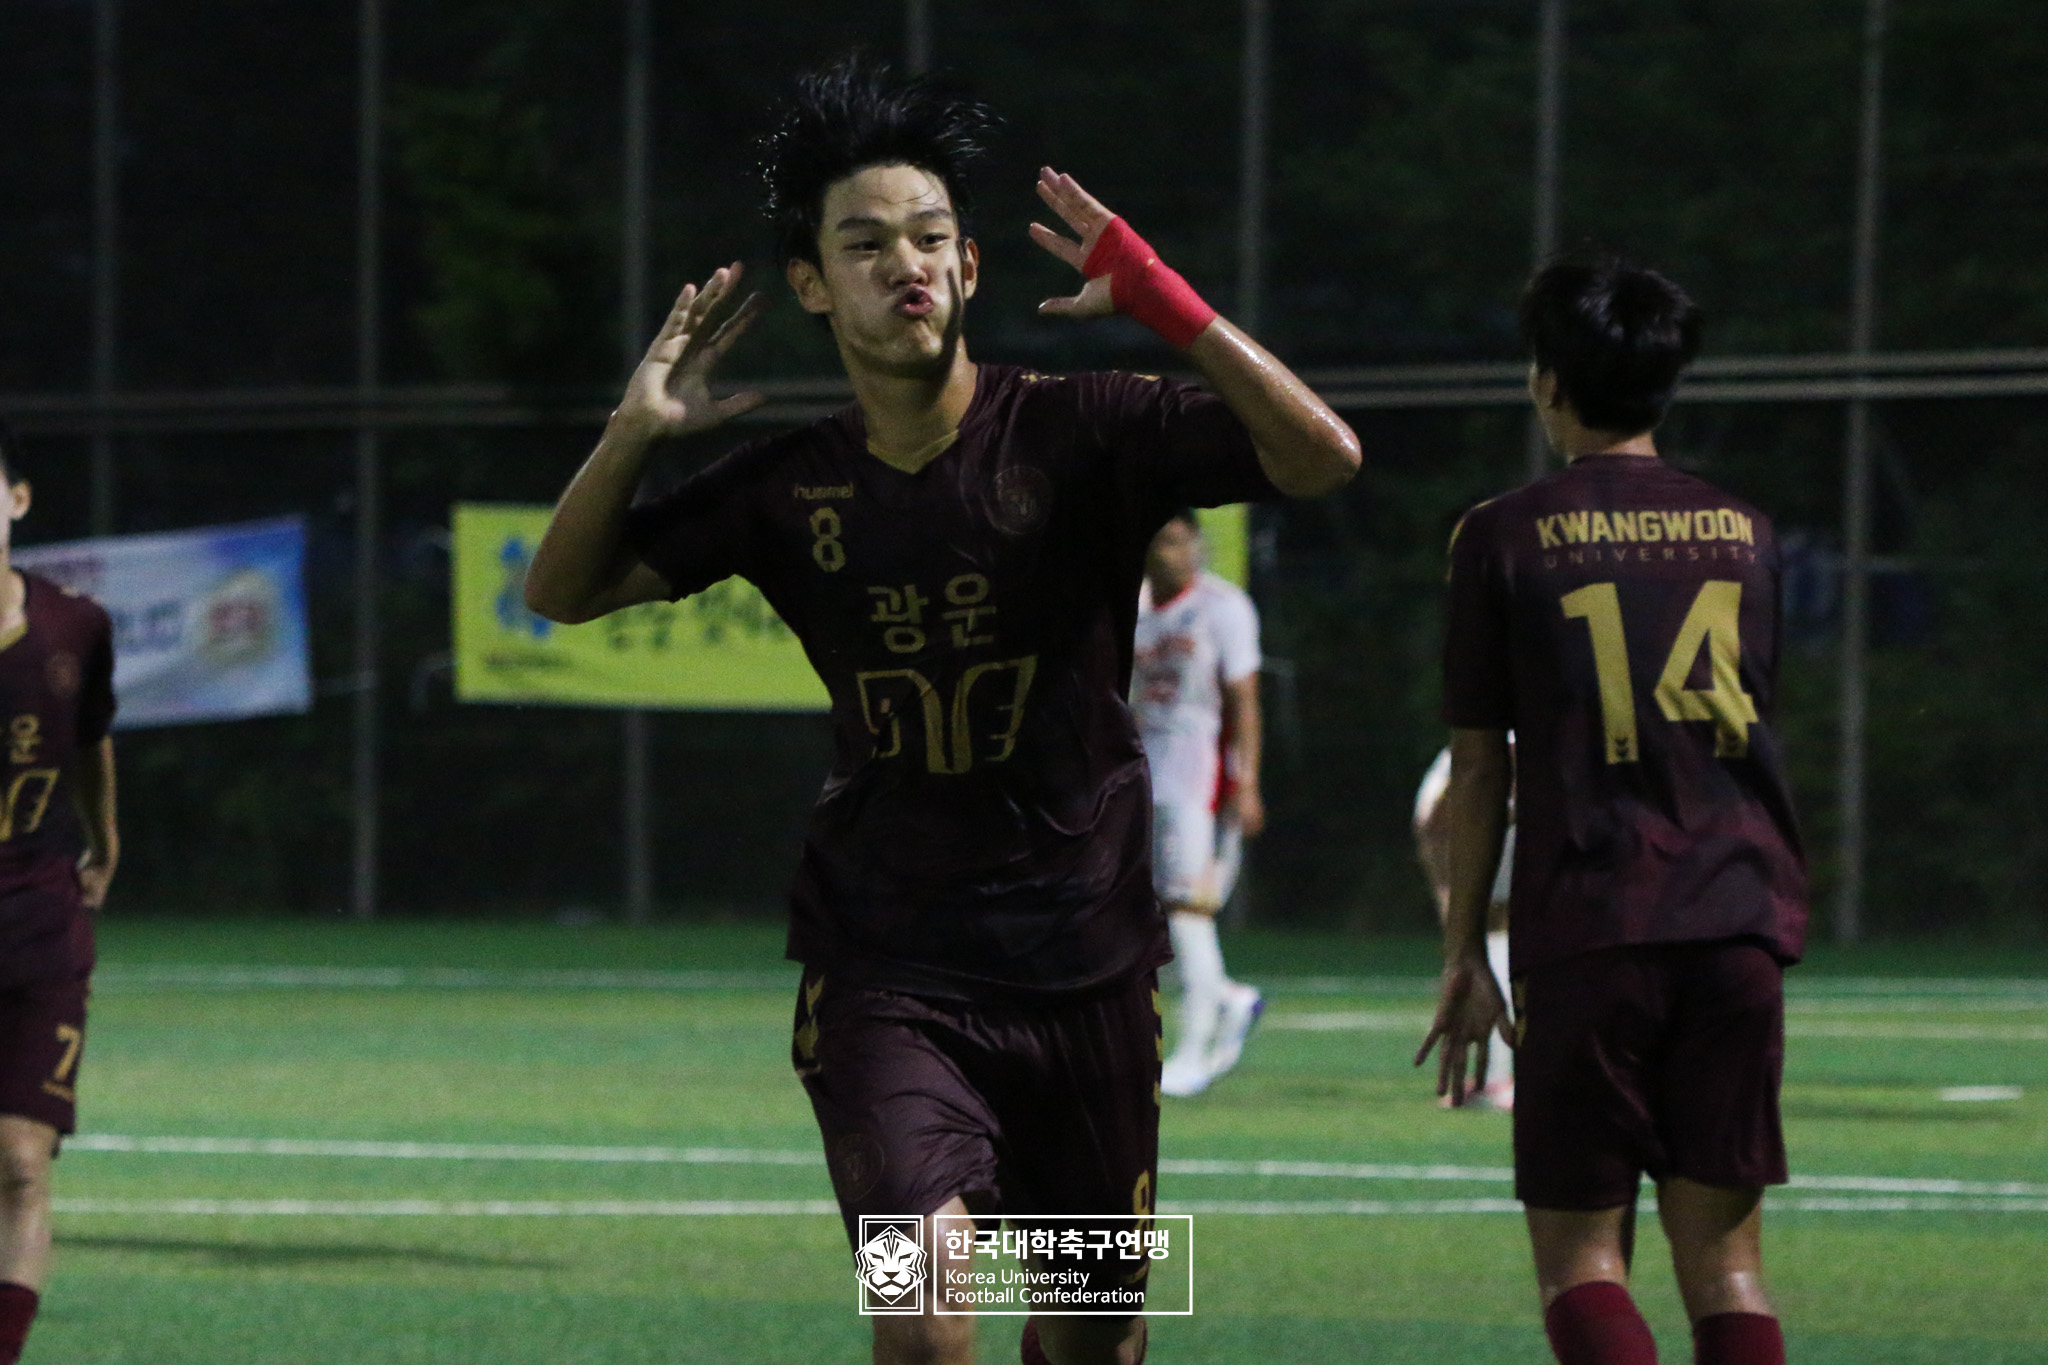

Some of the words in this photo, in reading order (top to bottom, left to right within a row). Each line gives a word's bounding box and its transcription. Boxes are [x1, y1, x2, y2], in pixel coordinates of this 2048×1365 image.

[809, 507, 846, 573] 8
[1535, 507, 1755, 549] KWANGWOON
[1543, 546, 1757, 569] UNIVERSITY
[866, 572, 997, 654] 광운
[1560, 580, 1760, 765] 14
[4, 713, 43, 764] 운
[53, 1023, 81, 1080] 7
